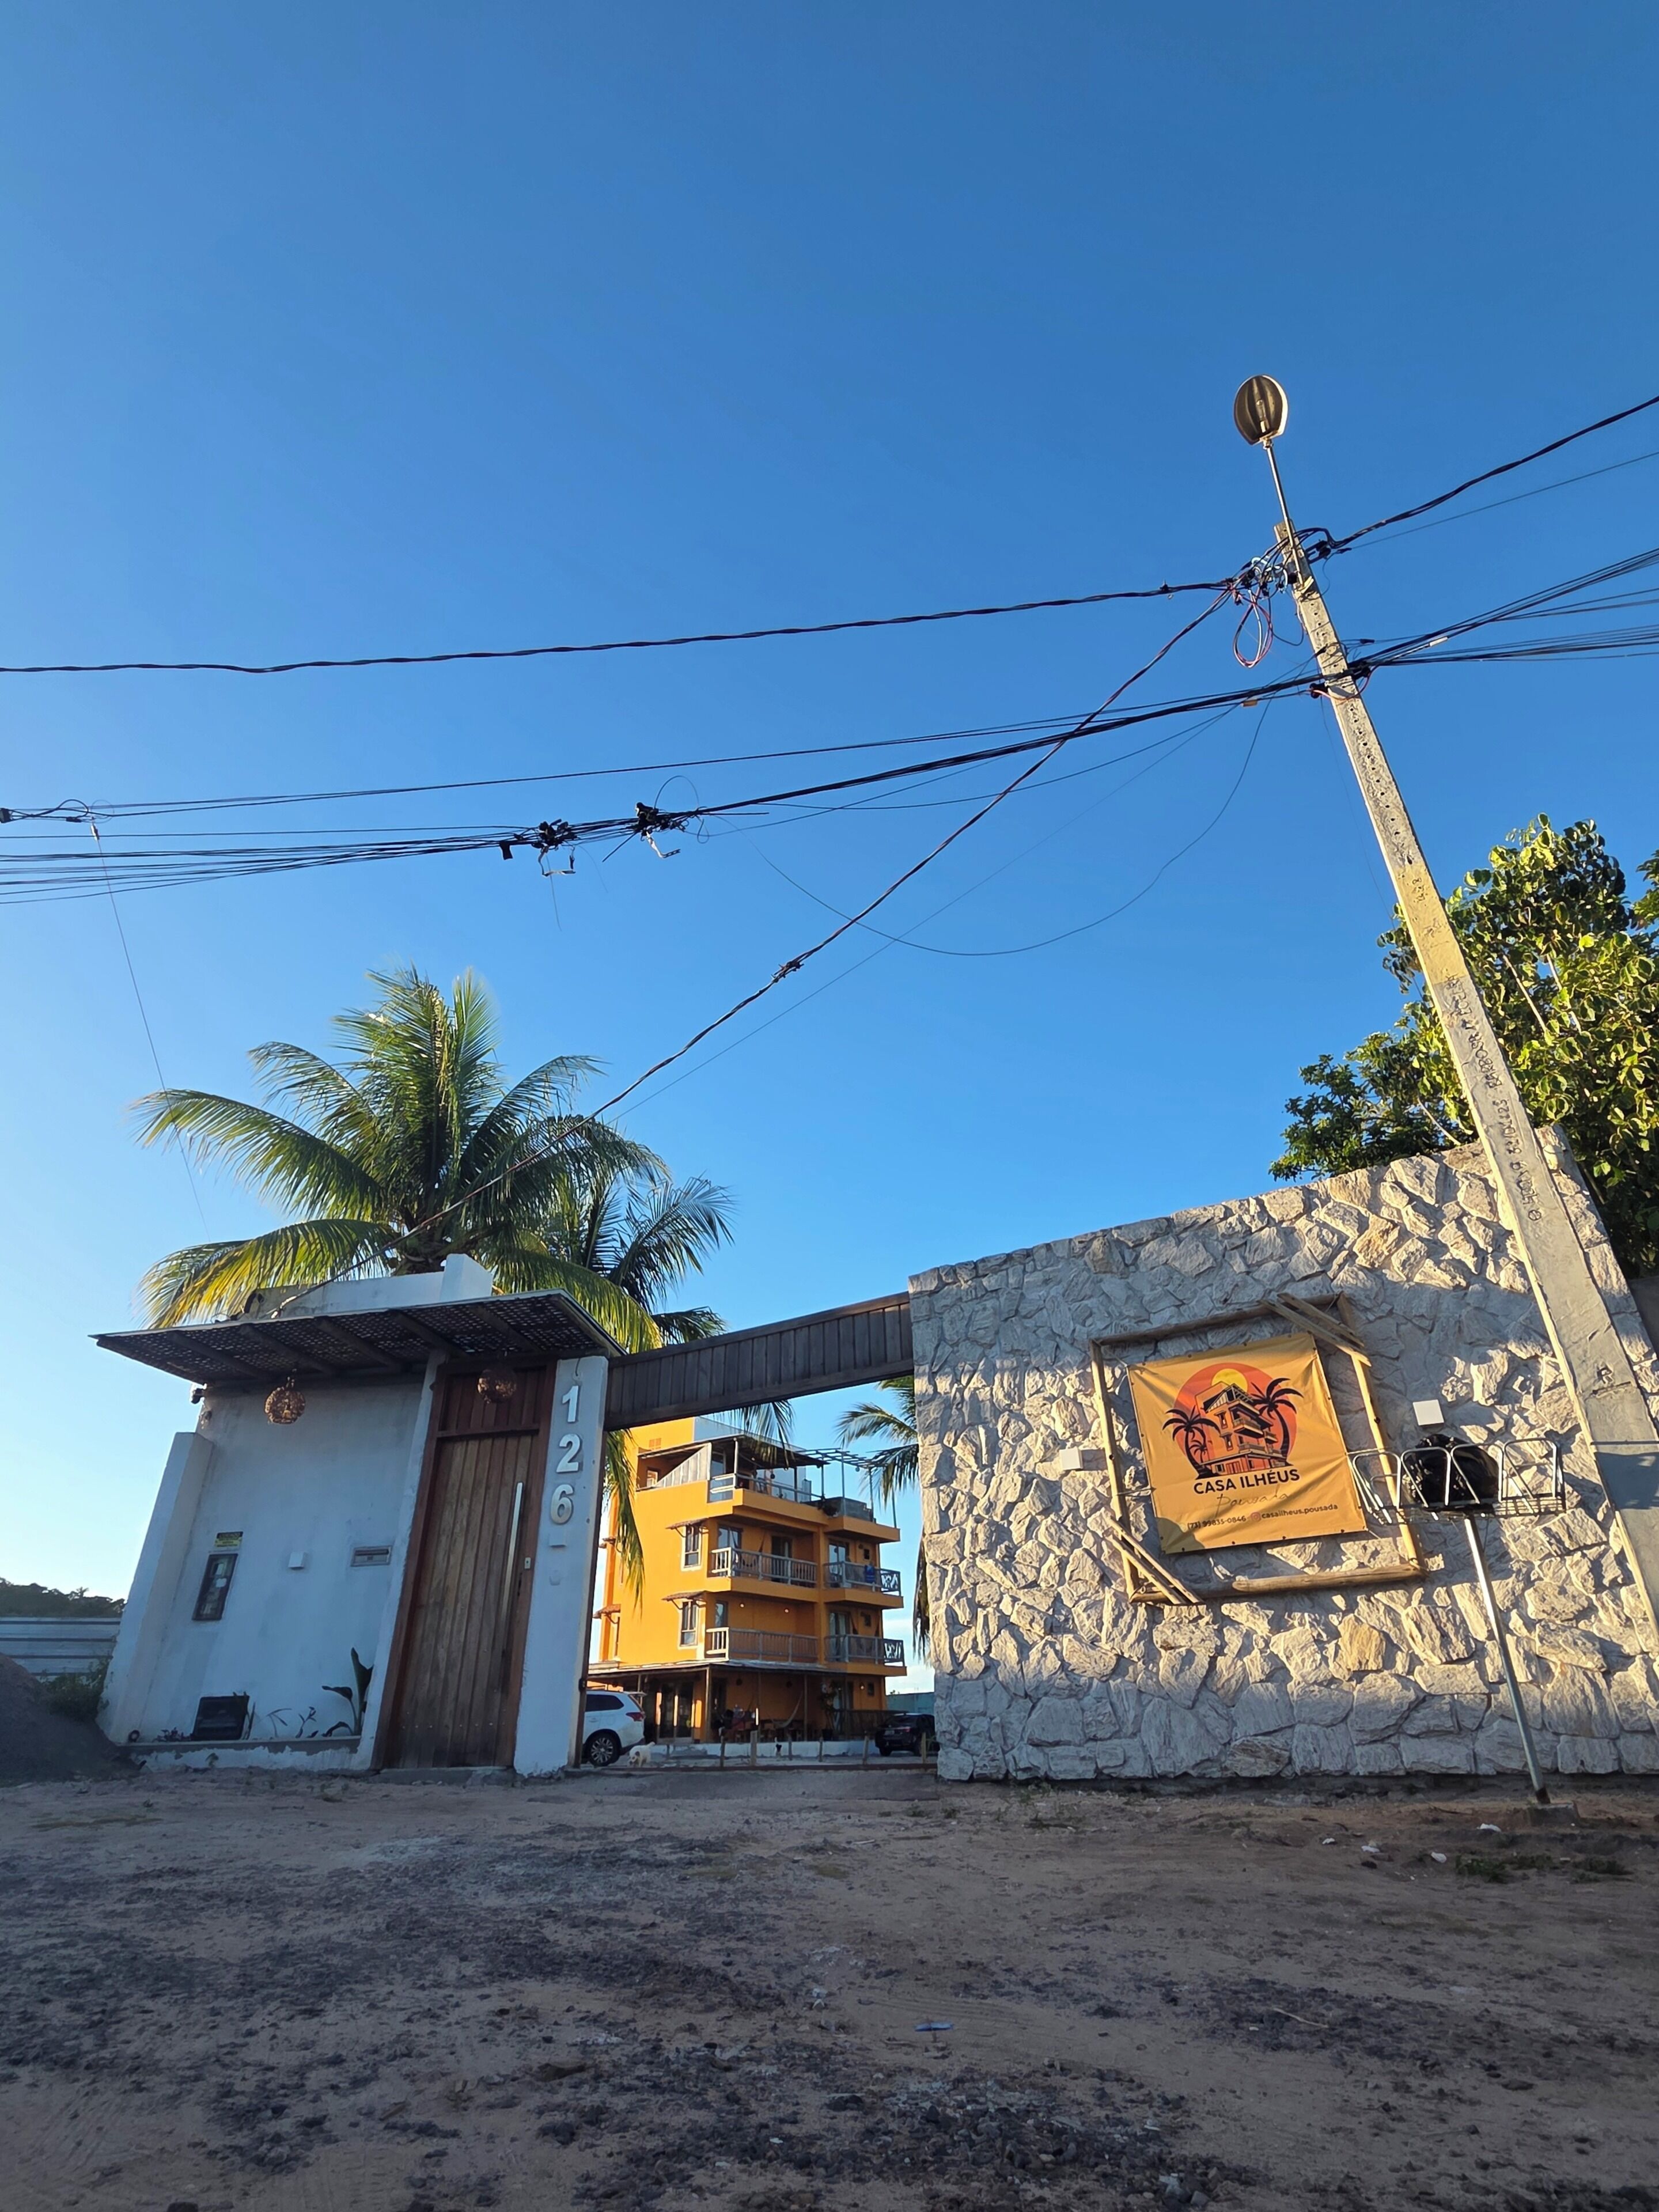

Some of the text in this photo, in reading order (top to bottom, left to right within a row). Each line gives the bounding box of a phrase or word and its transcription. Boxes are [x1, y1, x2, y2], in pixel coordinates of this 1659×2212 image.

[551, 1385, 581, 1525] 126
[1194, 1469, 1300, 1494] CASA ILHÉUS
[1215, 1484, 1289, 1518] Pousada
[1262, 1503, 1338, 1520] casailheus.pousada
[1187, 1520, 1202, 1531] (73)
